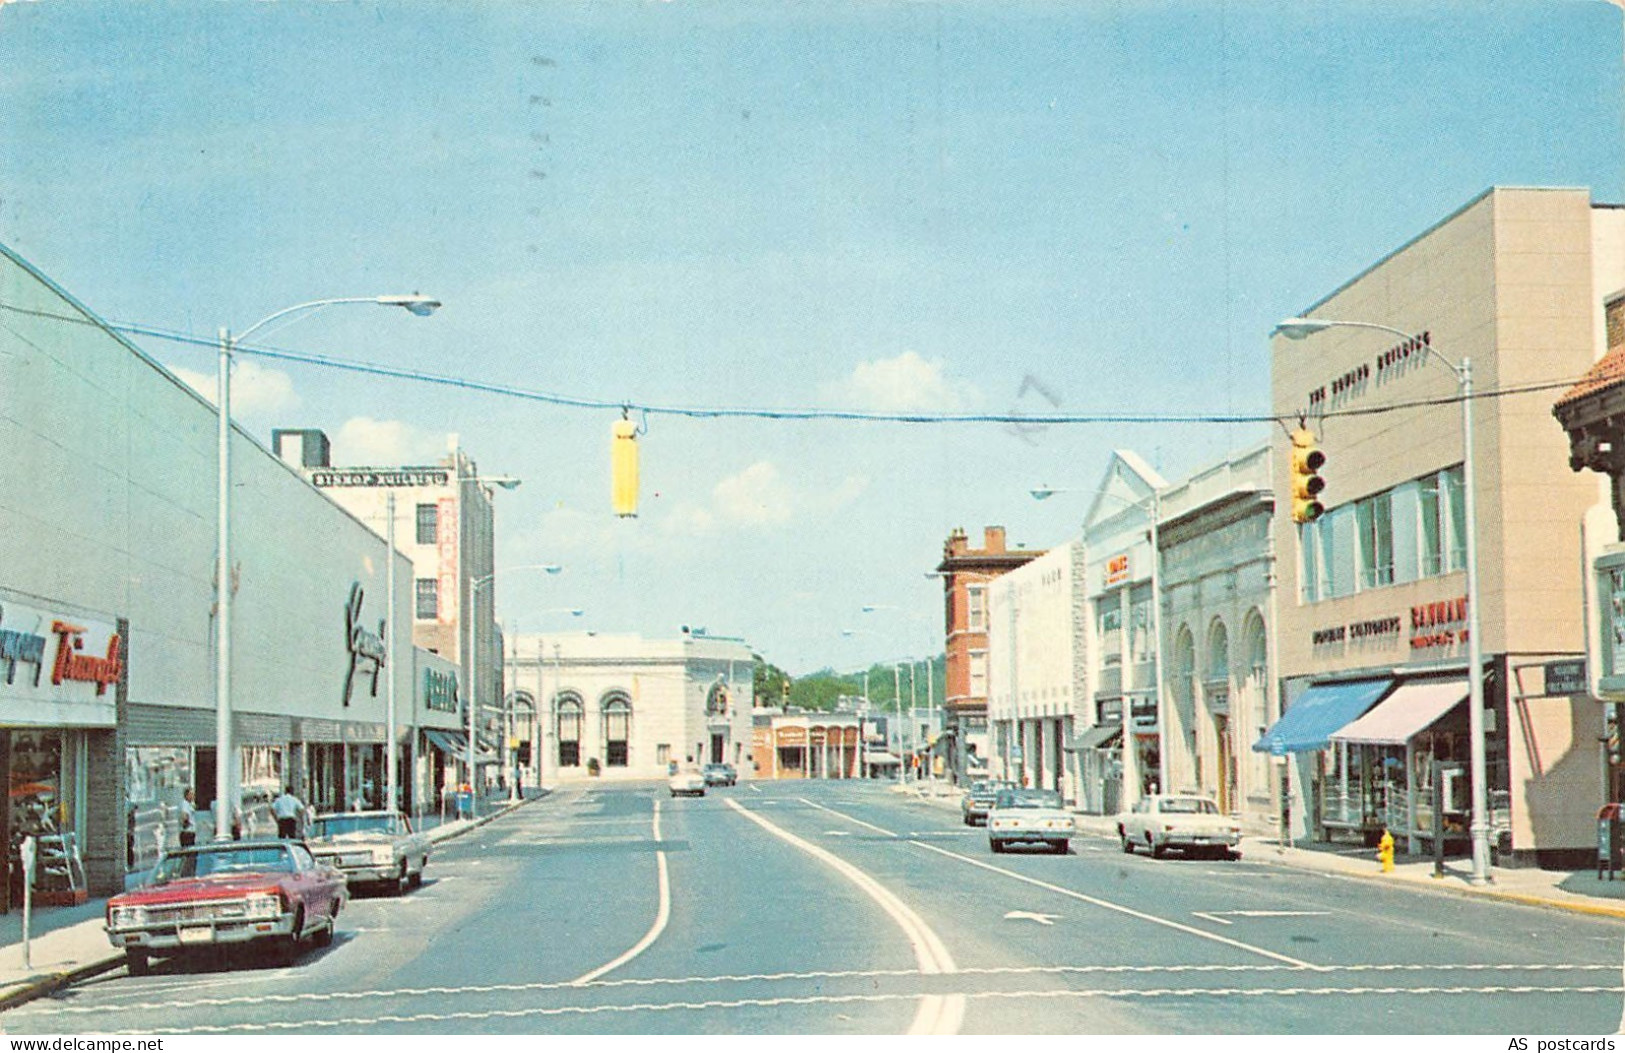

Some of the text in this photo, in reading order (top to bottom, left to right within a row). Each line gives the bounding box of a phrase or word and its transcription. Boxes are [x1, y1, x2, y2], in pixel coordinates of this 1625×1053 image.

[1308, 330, 1431, 406] THE BUILDING
[376, 472, 448, 486] BUILDING
